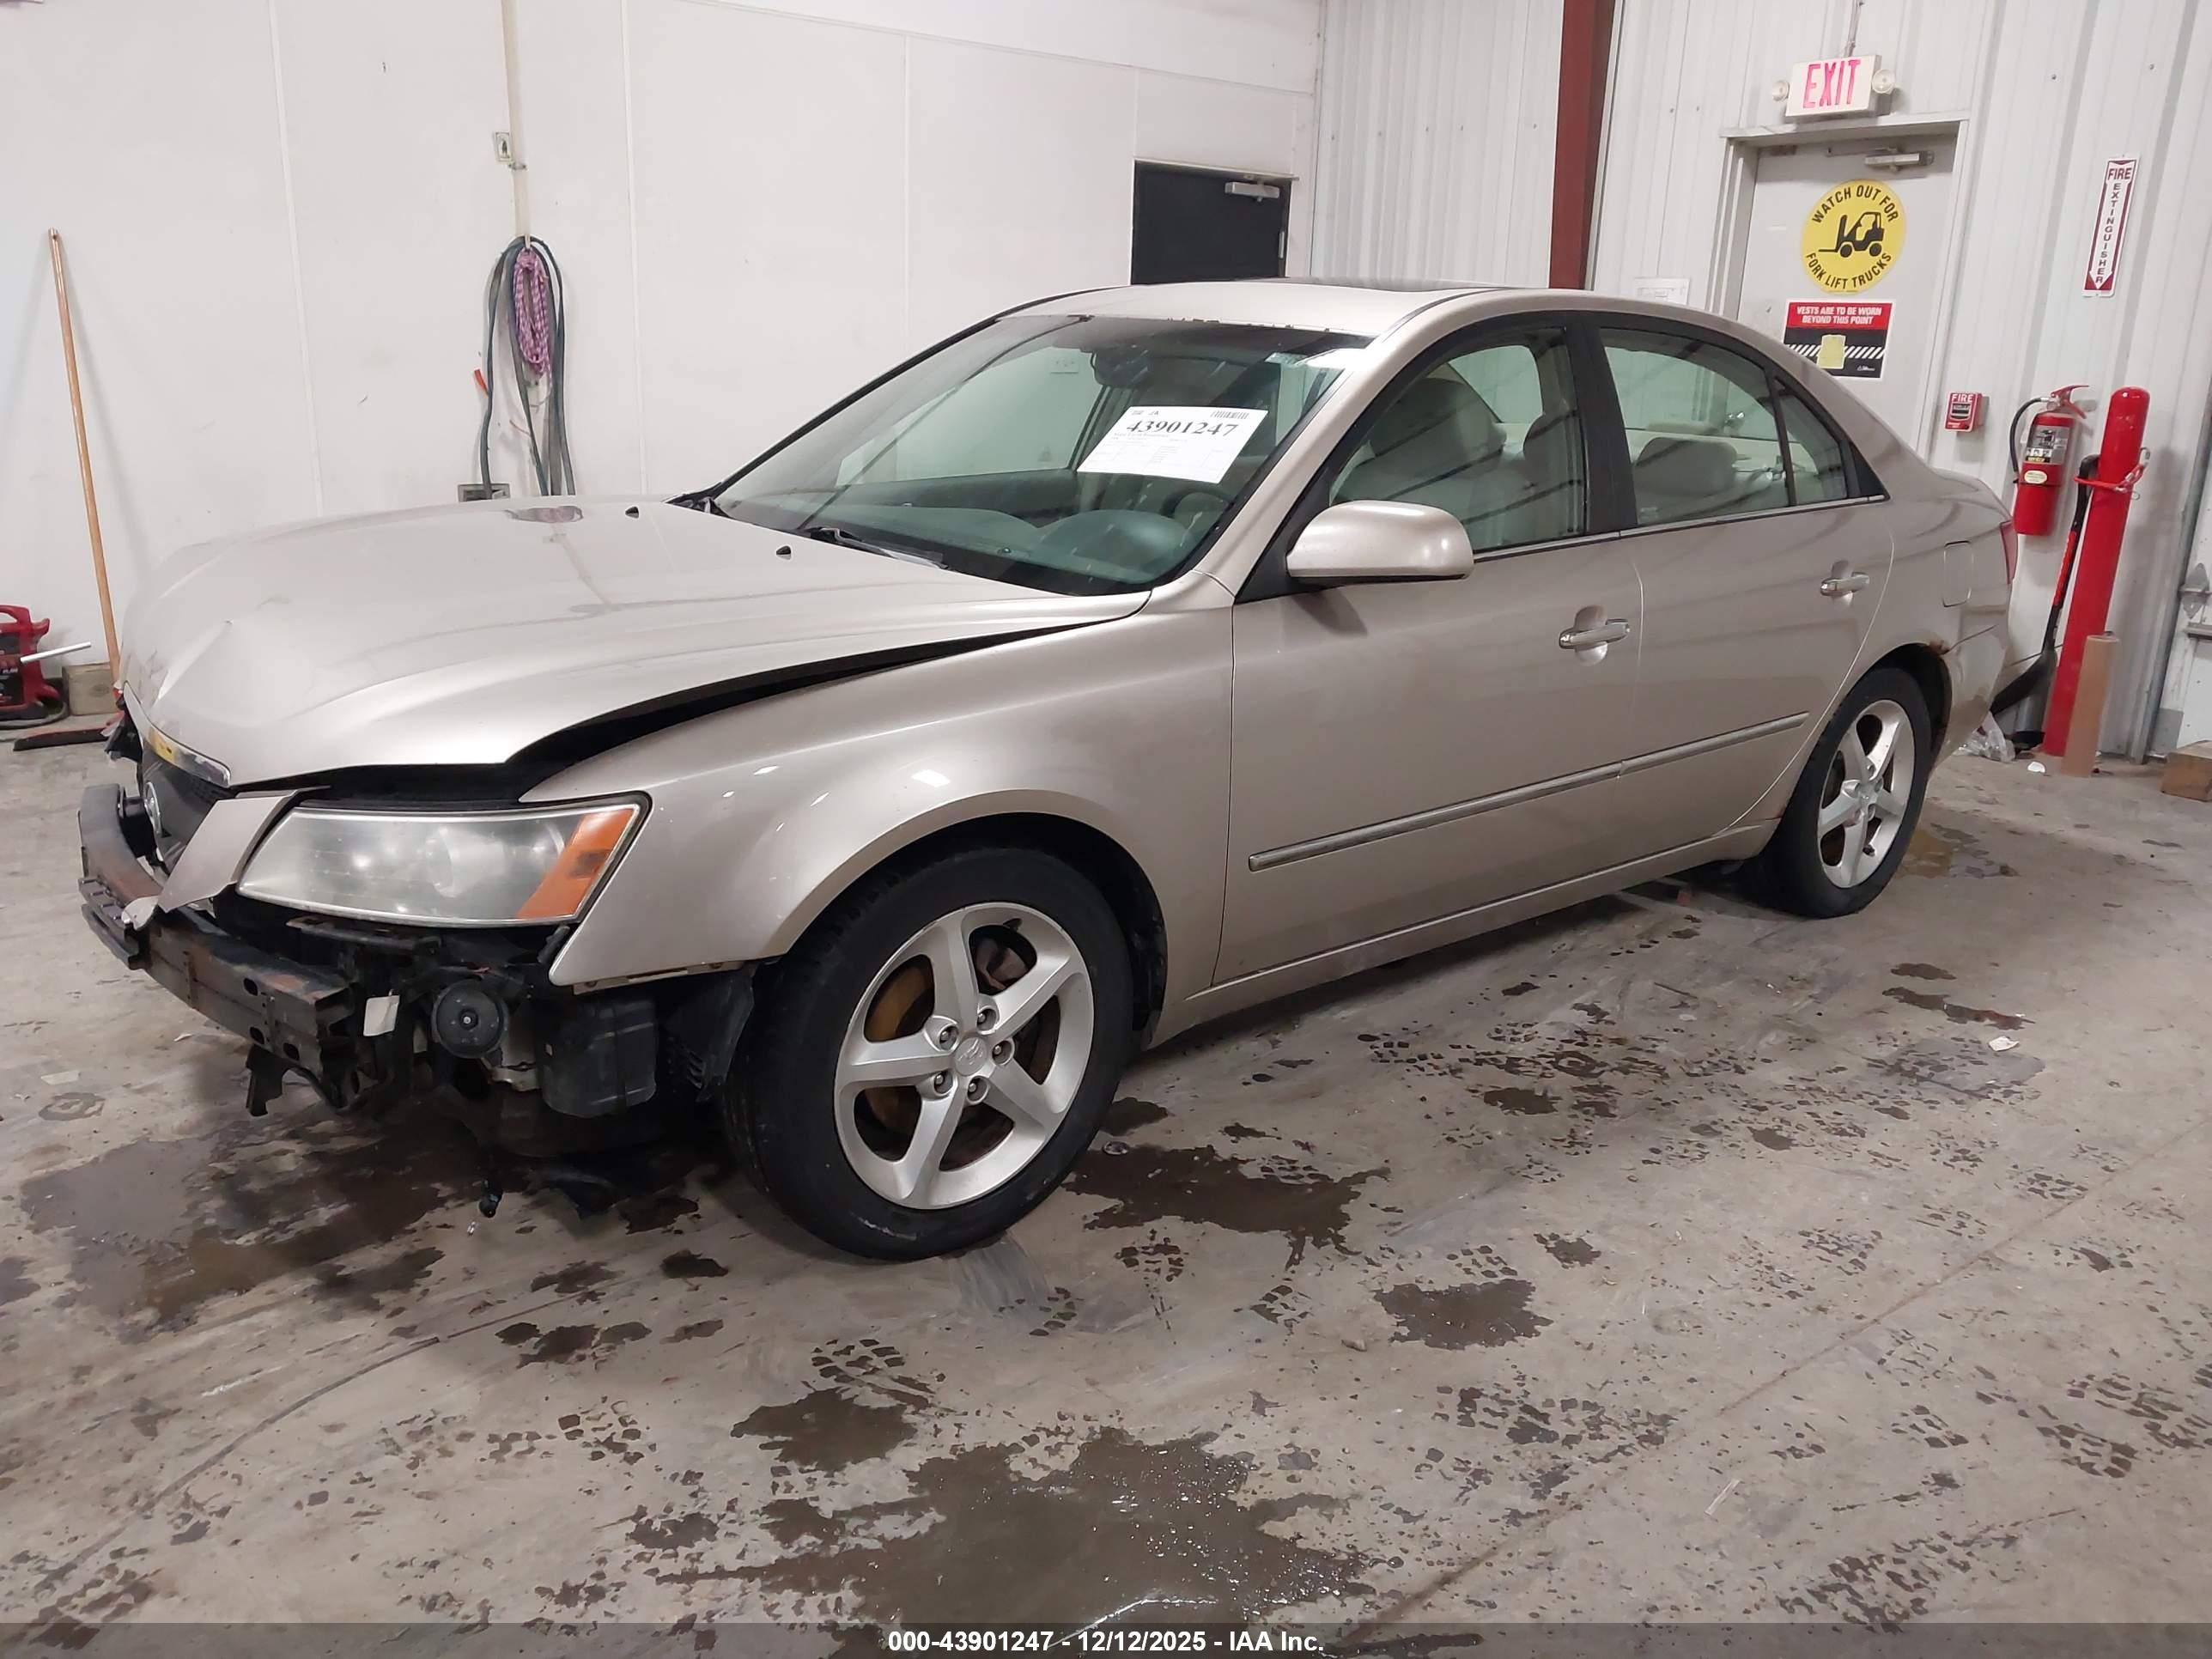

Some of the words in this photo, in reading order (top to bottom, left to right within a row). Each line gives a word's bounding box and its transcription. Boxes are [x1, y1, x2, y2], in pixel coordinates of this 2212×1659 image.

[1802, 59, 1861, 108] EXIT
[2107, 167, 2132, 180] FIRE
[1811, 186, 1851, 223] WATCH
[1856, 185, 1881, 200] OUT
[1879, 196, 1899, 222] FOR
[2095, 182, 2121, 283] EXTINGUISHER
[1806, 252, 1826, 281] FORK
[1825, 274, 1848, 289] LIFT
[1851, 252, 1892, 288] TRUCKS
[1796, 307, 1820, 315] VESTS
[1820, 307, 1835, 315] ARE
[1836, 307, 1846, 315] TO
[1858, 307, 1882, 316] WORN
[1802, 315, 1832, 324] BEYOND
[1832, 315, 1850, 324] THIS
[1850, 316, 1875, 325] POINT
[1951, 393, 1974, 403] FIRE
[1127, 420, 1239, 436] 43901247
